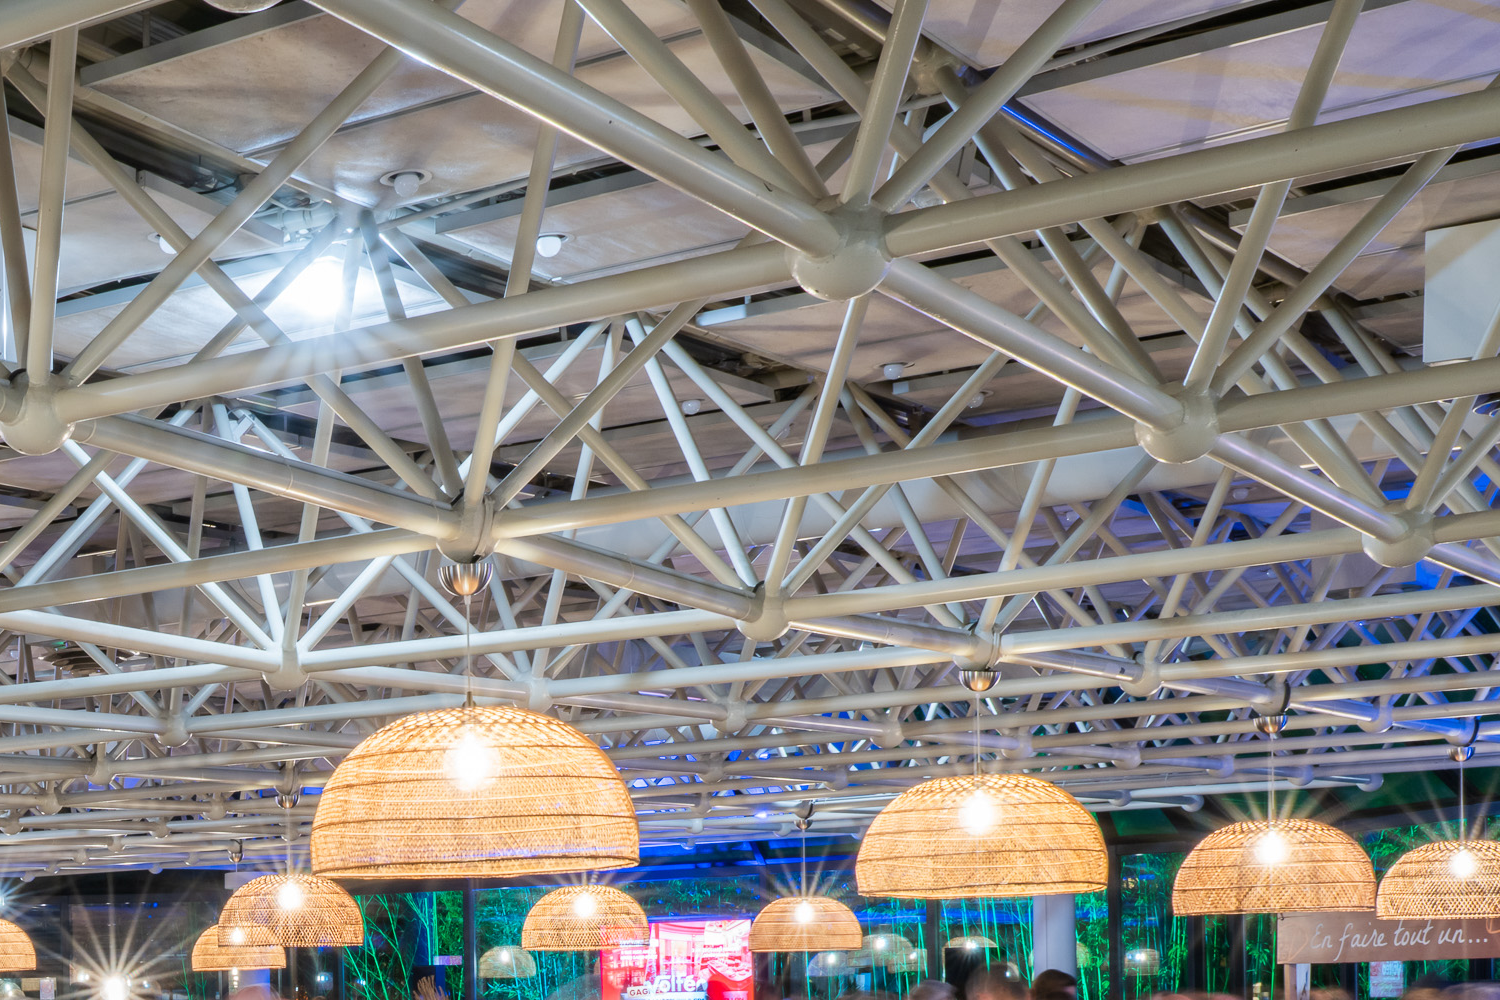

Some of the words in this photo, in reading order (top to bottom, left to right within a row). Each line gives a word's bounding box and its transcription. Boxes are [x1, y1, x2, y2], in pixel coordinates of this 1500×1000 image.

[1310, 923, 1333, 949] En
[1333, 922, 1388, 962] faire
[1394, 918, 1434, 947] tout
